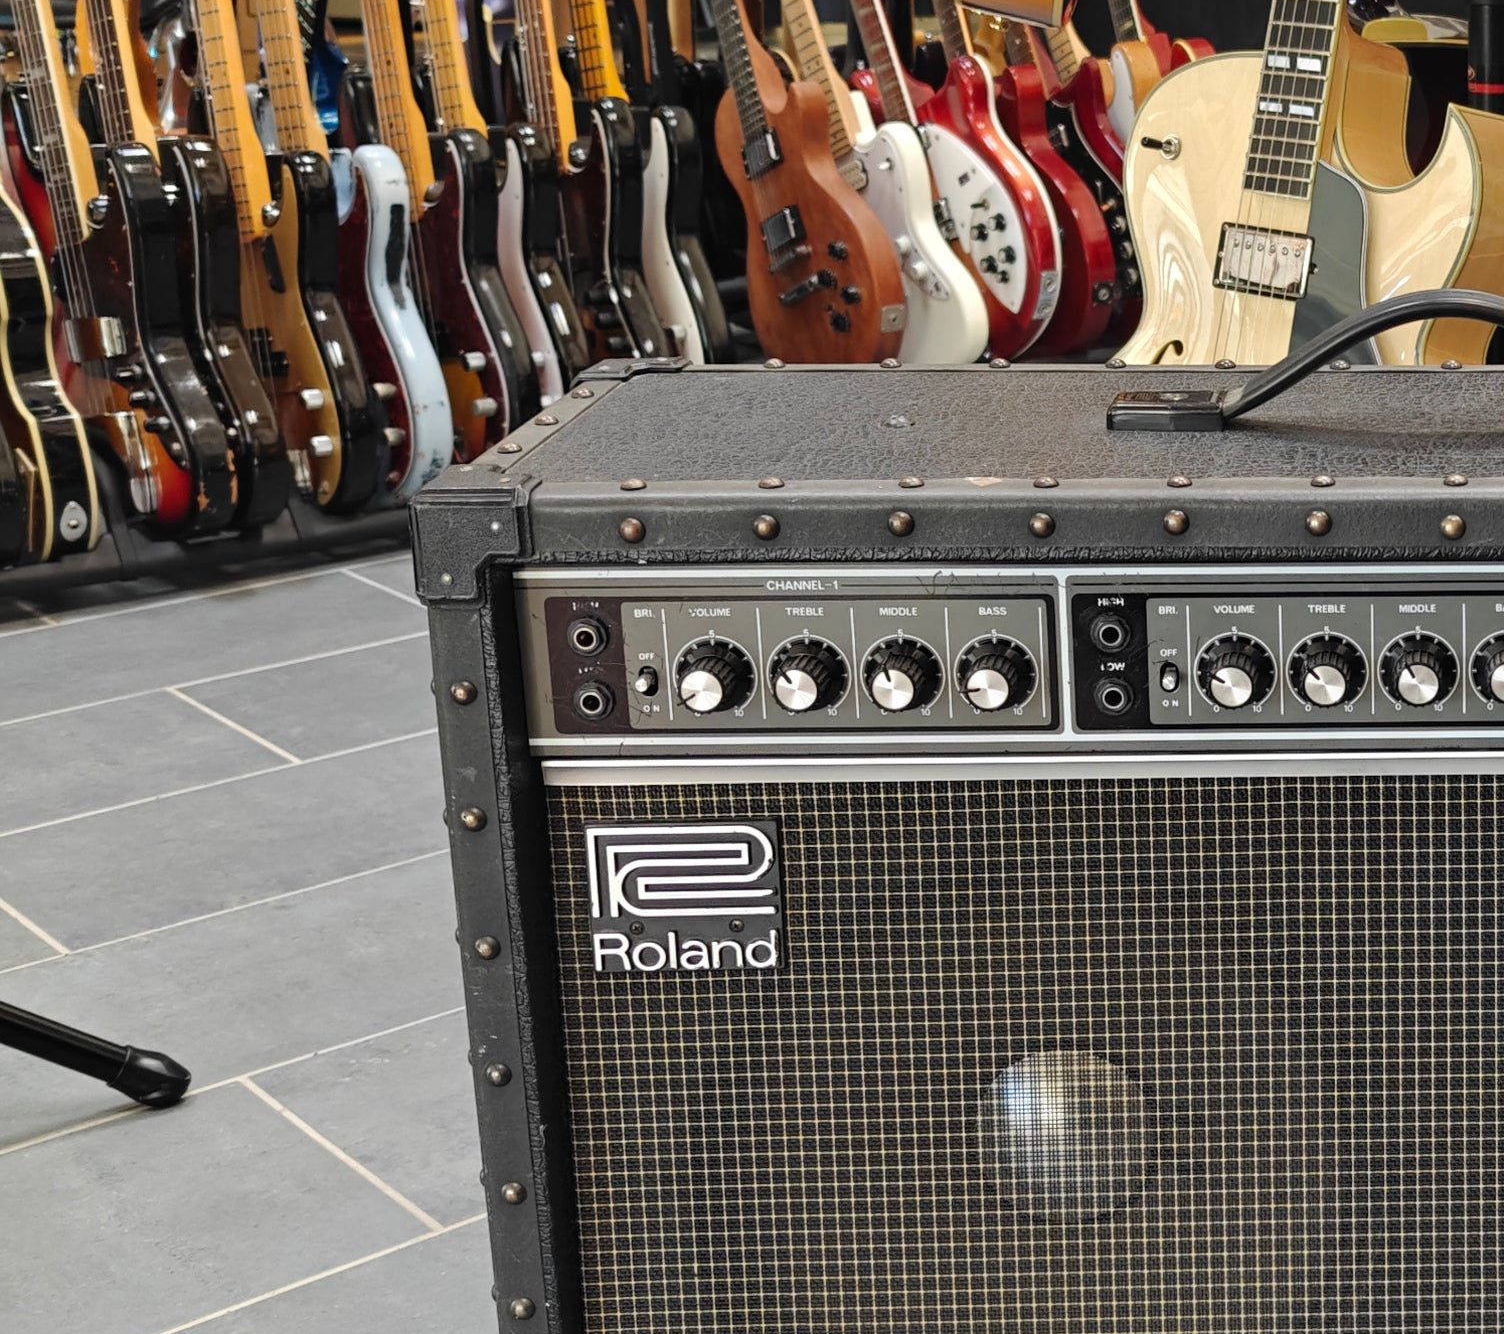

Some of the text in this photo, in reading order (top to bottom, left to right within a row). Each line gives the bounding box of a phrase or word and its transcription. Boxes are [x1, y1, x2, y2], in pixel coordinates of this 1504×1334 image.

[766, 580, 839, 591] CHANNEL-1
[689, 607, 731, 617] VOLUME
[785, 607, 824, 616] TREBLE
[879, 607, 918, 616] MIDDLE
[978, 607, 1007, 616] BASS
[1158, 606, 1178, 615] BRI.
[1213, 604, 1255, 614] VOLUME
[1307, 604, 1346, 613] TREBLE
[1398, 604, 1436, 613] MIDDLE
[638, 652, 655, 661] OFF
[1160, 648, 1178, 657] OFF
[828, 708, 838, 716] 10
[921, 708, 931, 716] 10
[1013, 707, 1023, 715] 10
[1253, 704, 1262, 713] 10
[1344, 704, 1353, 712] 10
[1434, 703, 1443, 712] 10
[734, 709, 744, 717] 10
[594, 930, 777, 971] Roland
